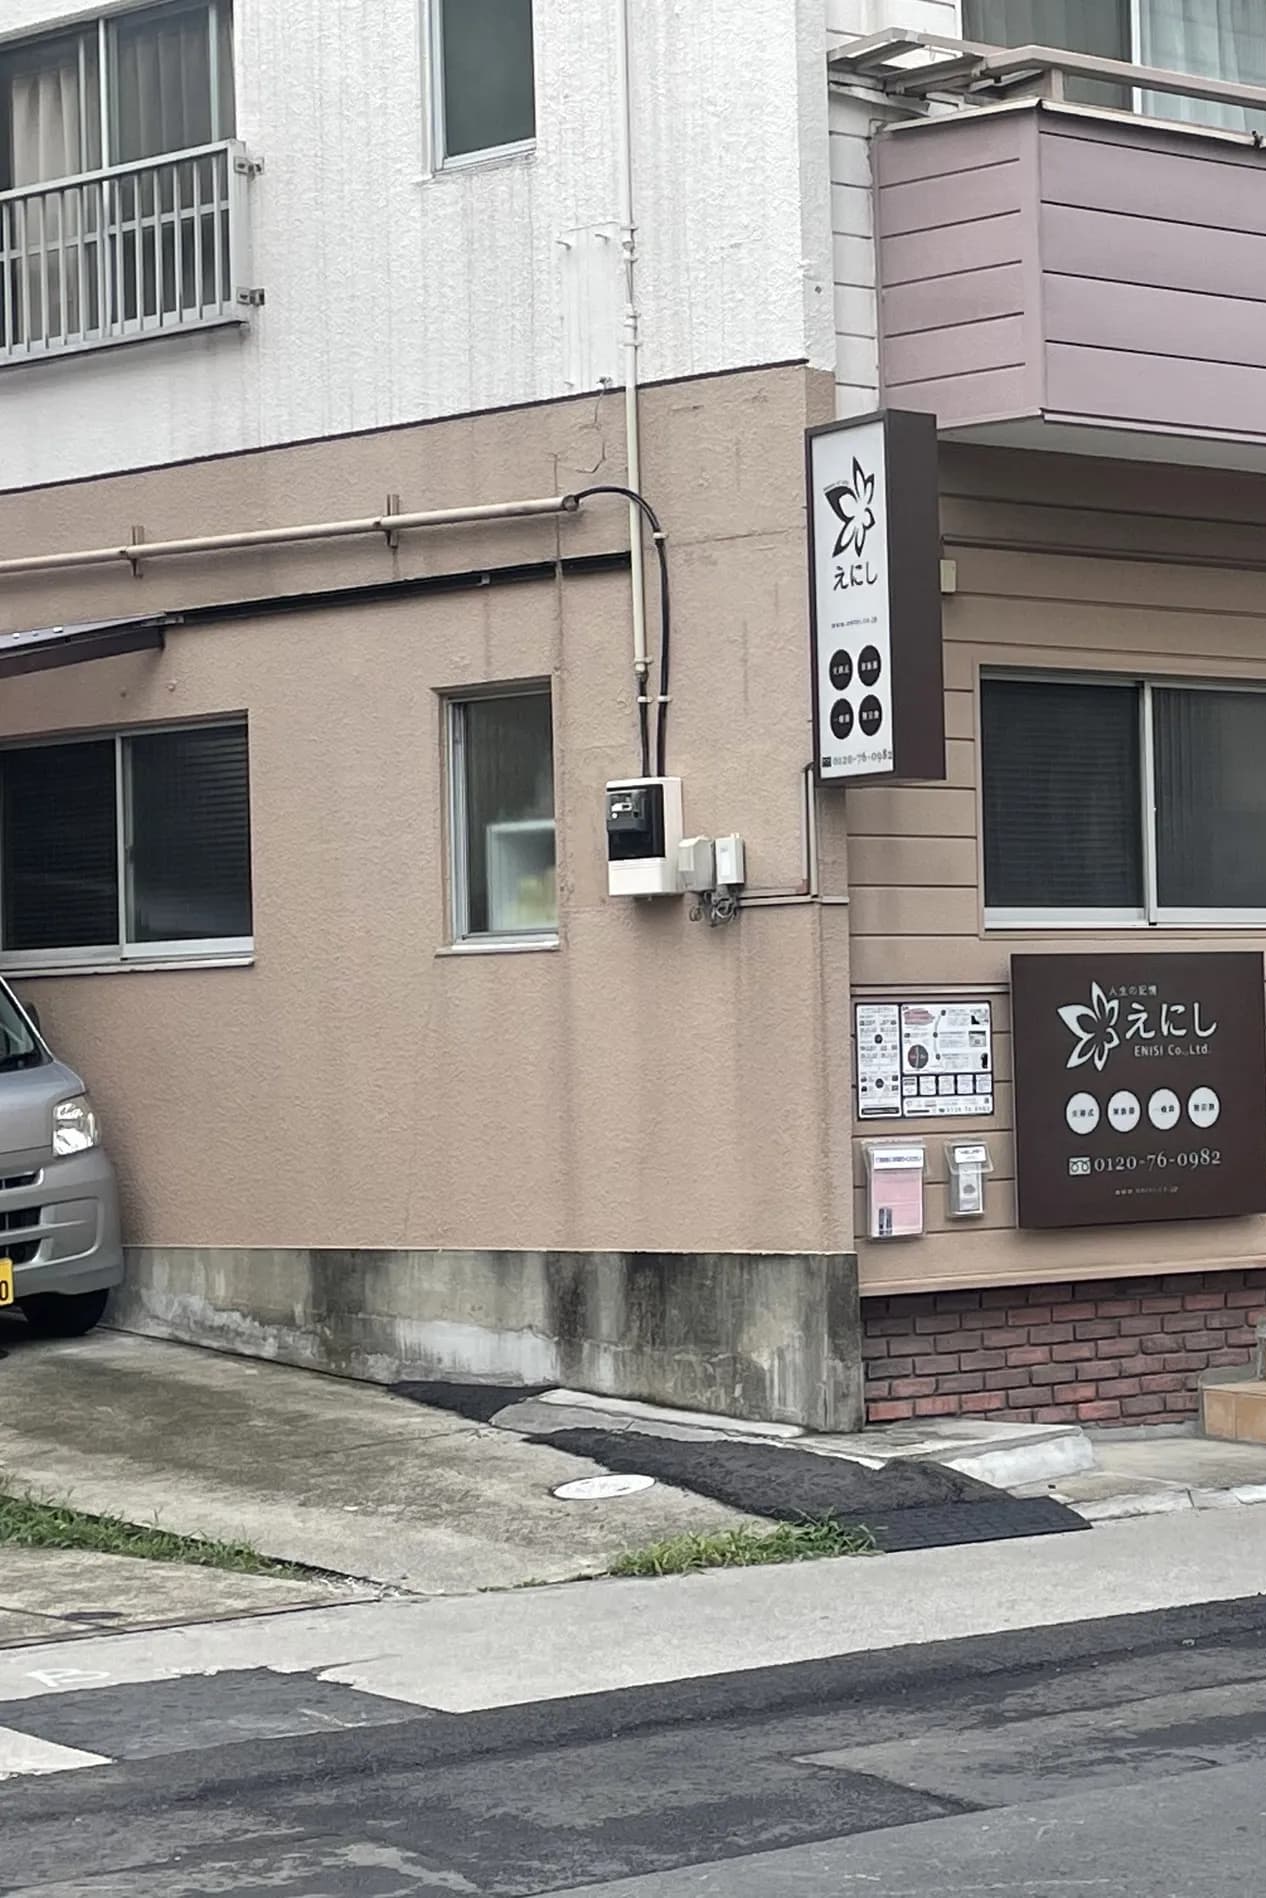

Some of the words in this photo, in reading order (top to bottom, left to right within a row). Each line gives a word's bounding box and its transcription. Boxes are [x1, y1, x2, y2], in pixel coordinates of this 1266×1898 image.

[833, 561, 878, 591] えにし
[1125, 1002, 1217, 1039] えにし
[1134, 1045, 1164, 1057] ENISI
[1094, 1148, 1222, 1173] 0120-76-0982
